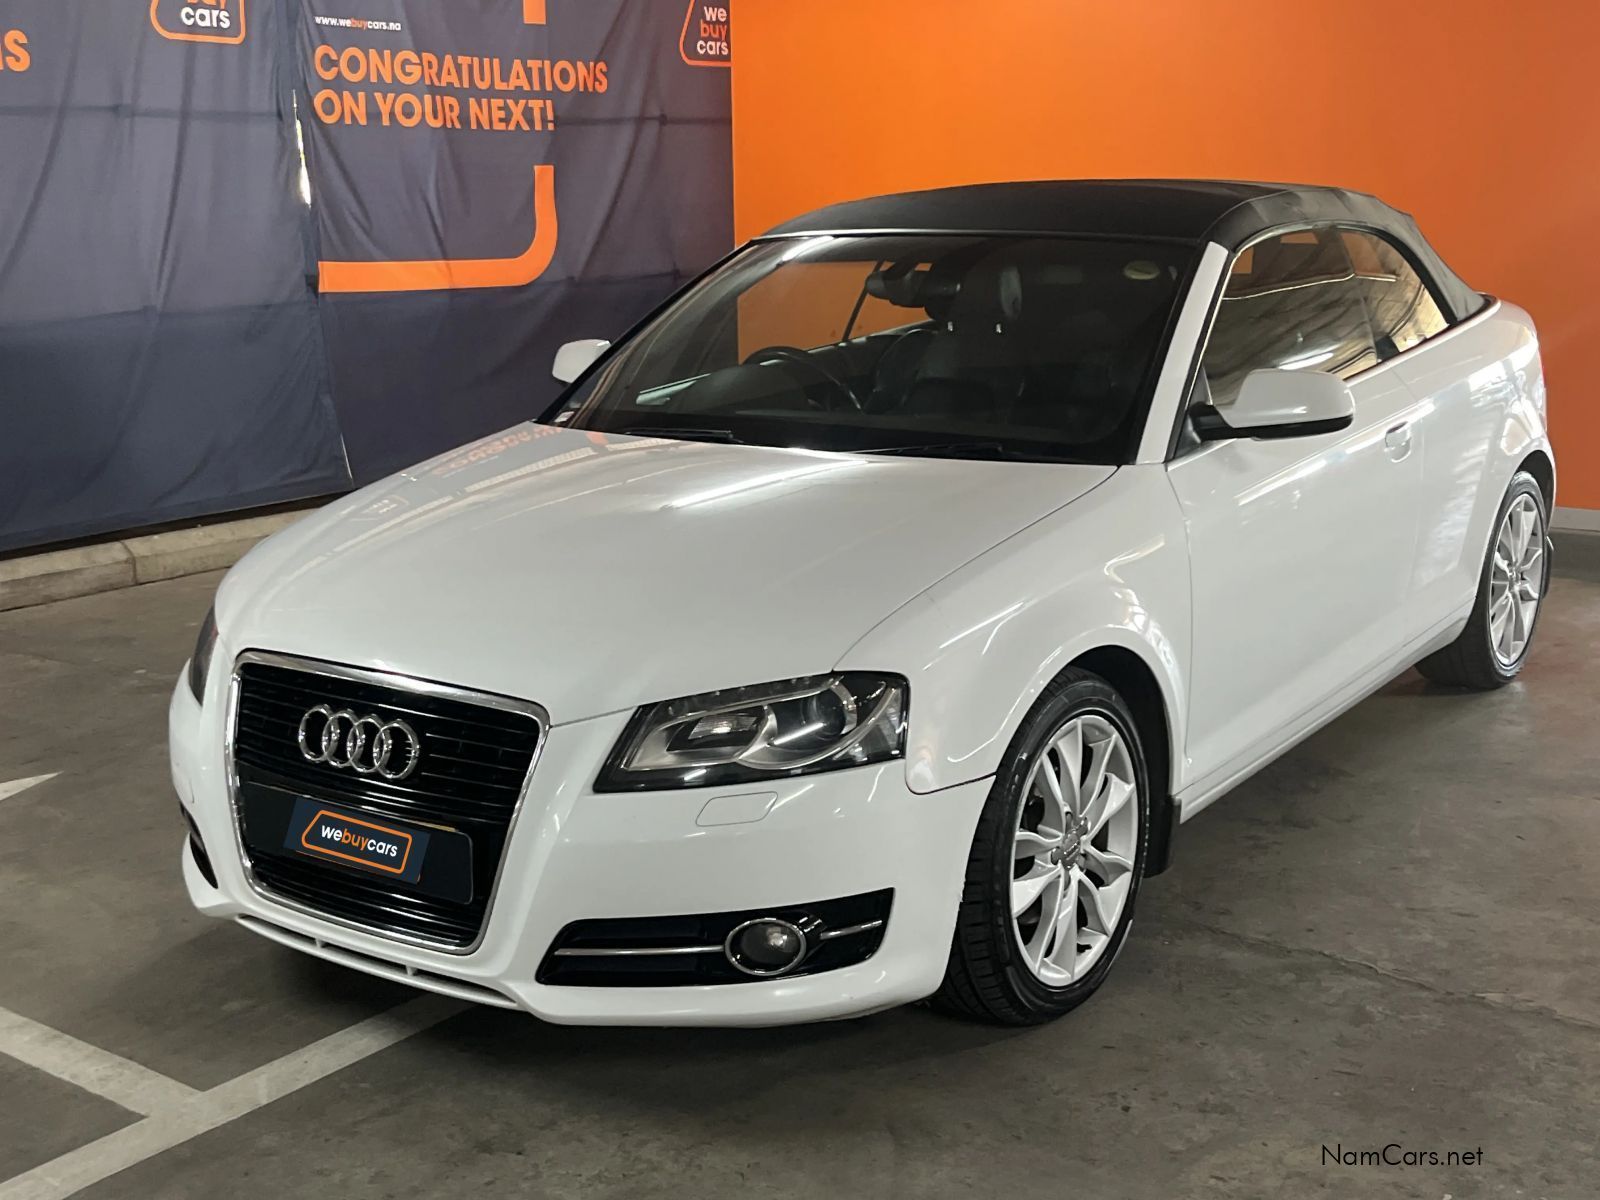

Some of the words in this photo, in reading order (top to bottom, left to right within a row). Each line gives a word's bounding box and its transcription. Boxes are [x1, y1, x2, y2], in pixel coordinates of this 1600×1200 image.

[181, 7, 231, 29] cars
[314, 16, 402, 31] www.webuycars.na
[703, 6, 728, 22] we
[700, 18, 727, 41] buy
[0, 29, 31, 72] S
[696, 40, 729, 55] cars
[314, 44, 608, 93] CONGRATULATIONS
[313, 89, 367, 126] ON
[375, 92, 460, 129] YOUR
[469, 97, 555, 131] NEXT!
[321, 824, 398, 858] webuycars
